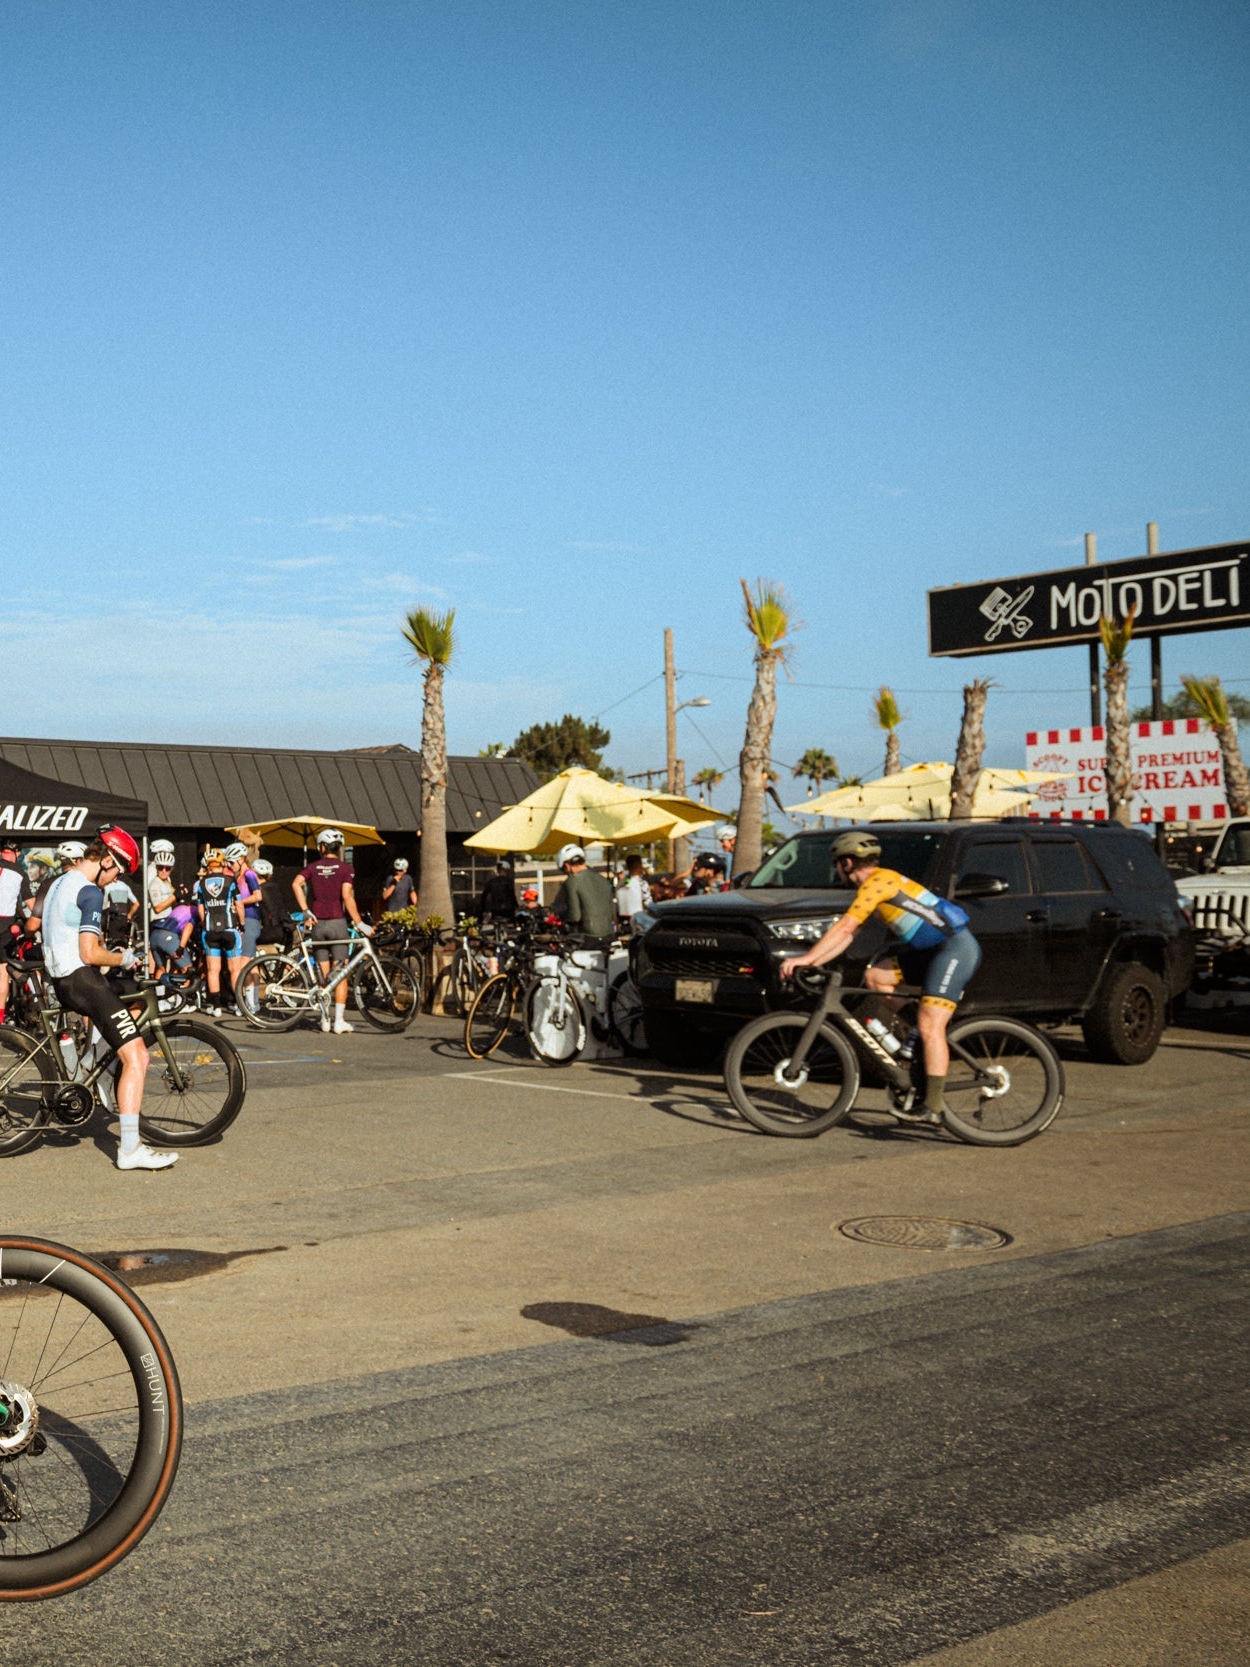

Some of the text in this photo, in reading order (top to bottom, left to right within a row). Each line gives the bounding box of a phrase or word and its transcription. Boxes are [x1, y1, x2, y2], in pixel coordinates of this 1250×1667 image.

[1050, 560, 1240, 631] MOTO DELI
[1138, 750, 1221, 769] PREMIUM
[1078, 774, 1109, 794] IC
[679, 937, 718, 948] TOYOTA
[110, 1009, 137, 1039] PVR
[845, 1018, 898, 1067] SCOTT
[145, 1366, 165, 1415] HUNT
